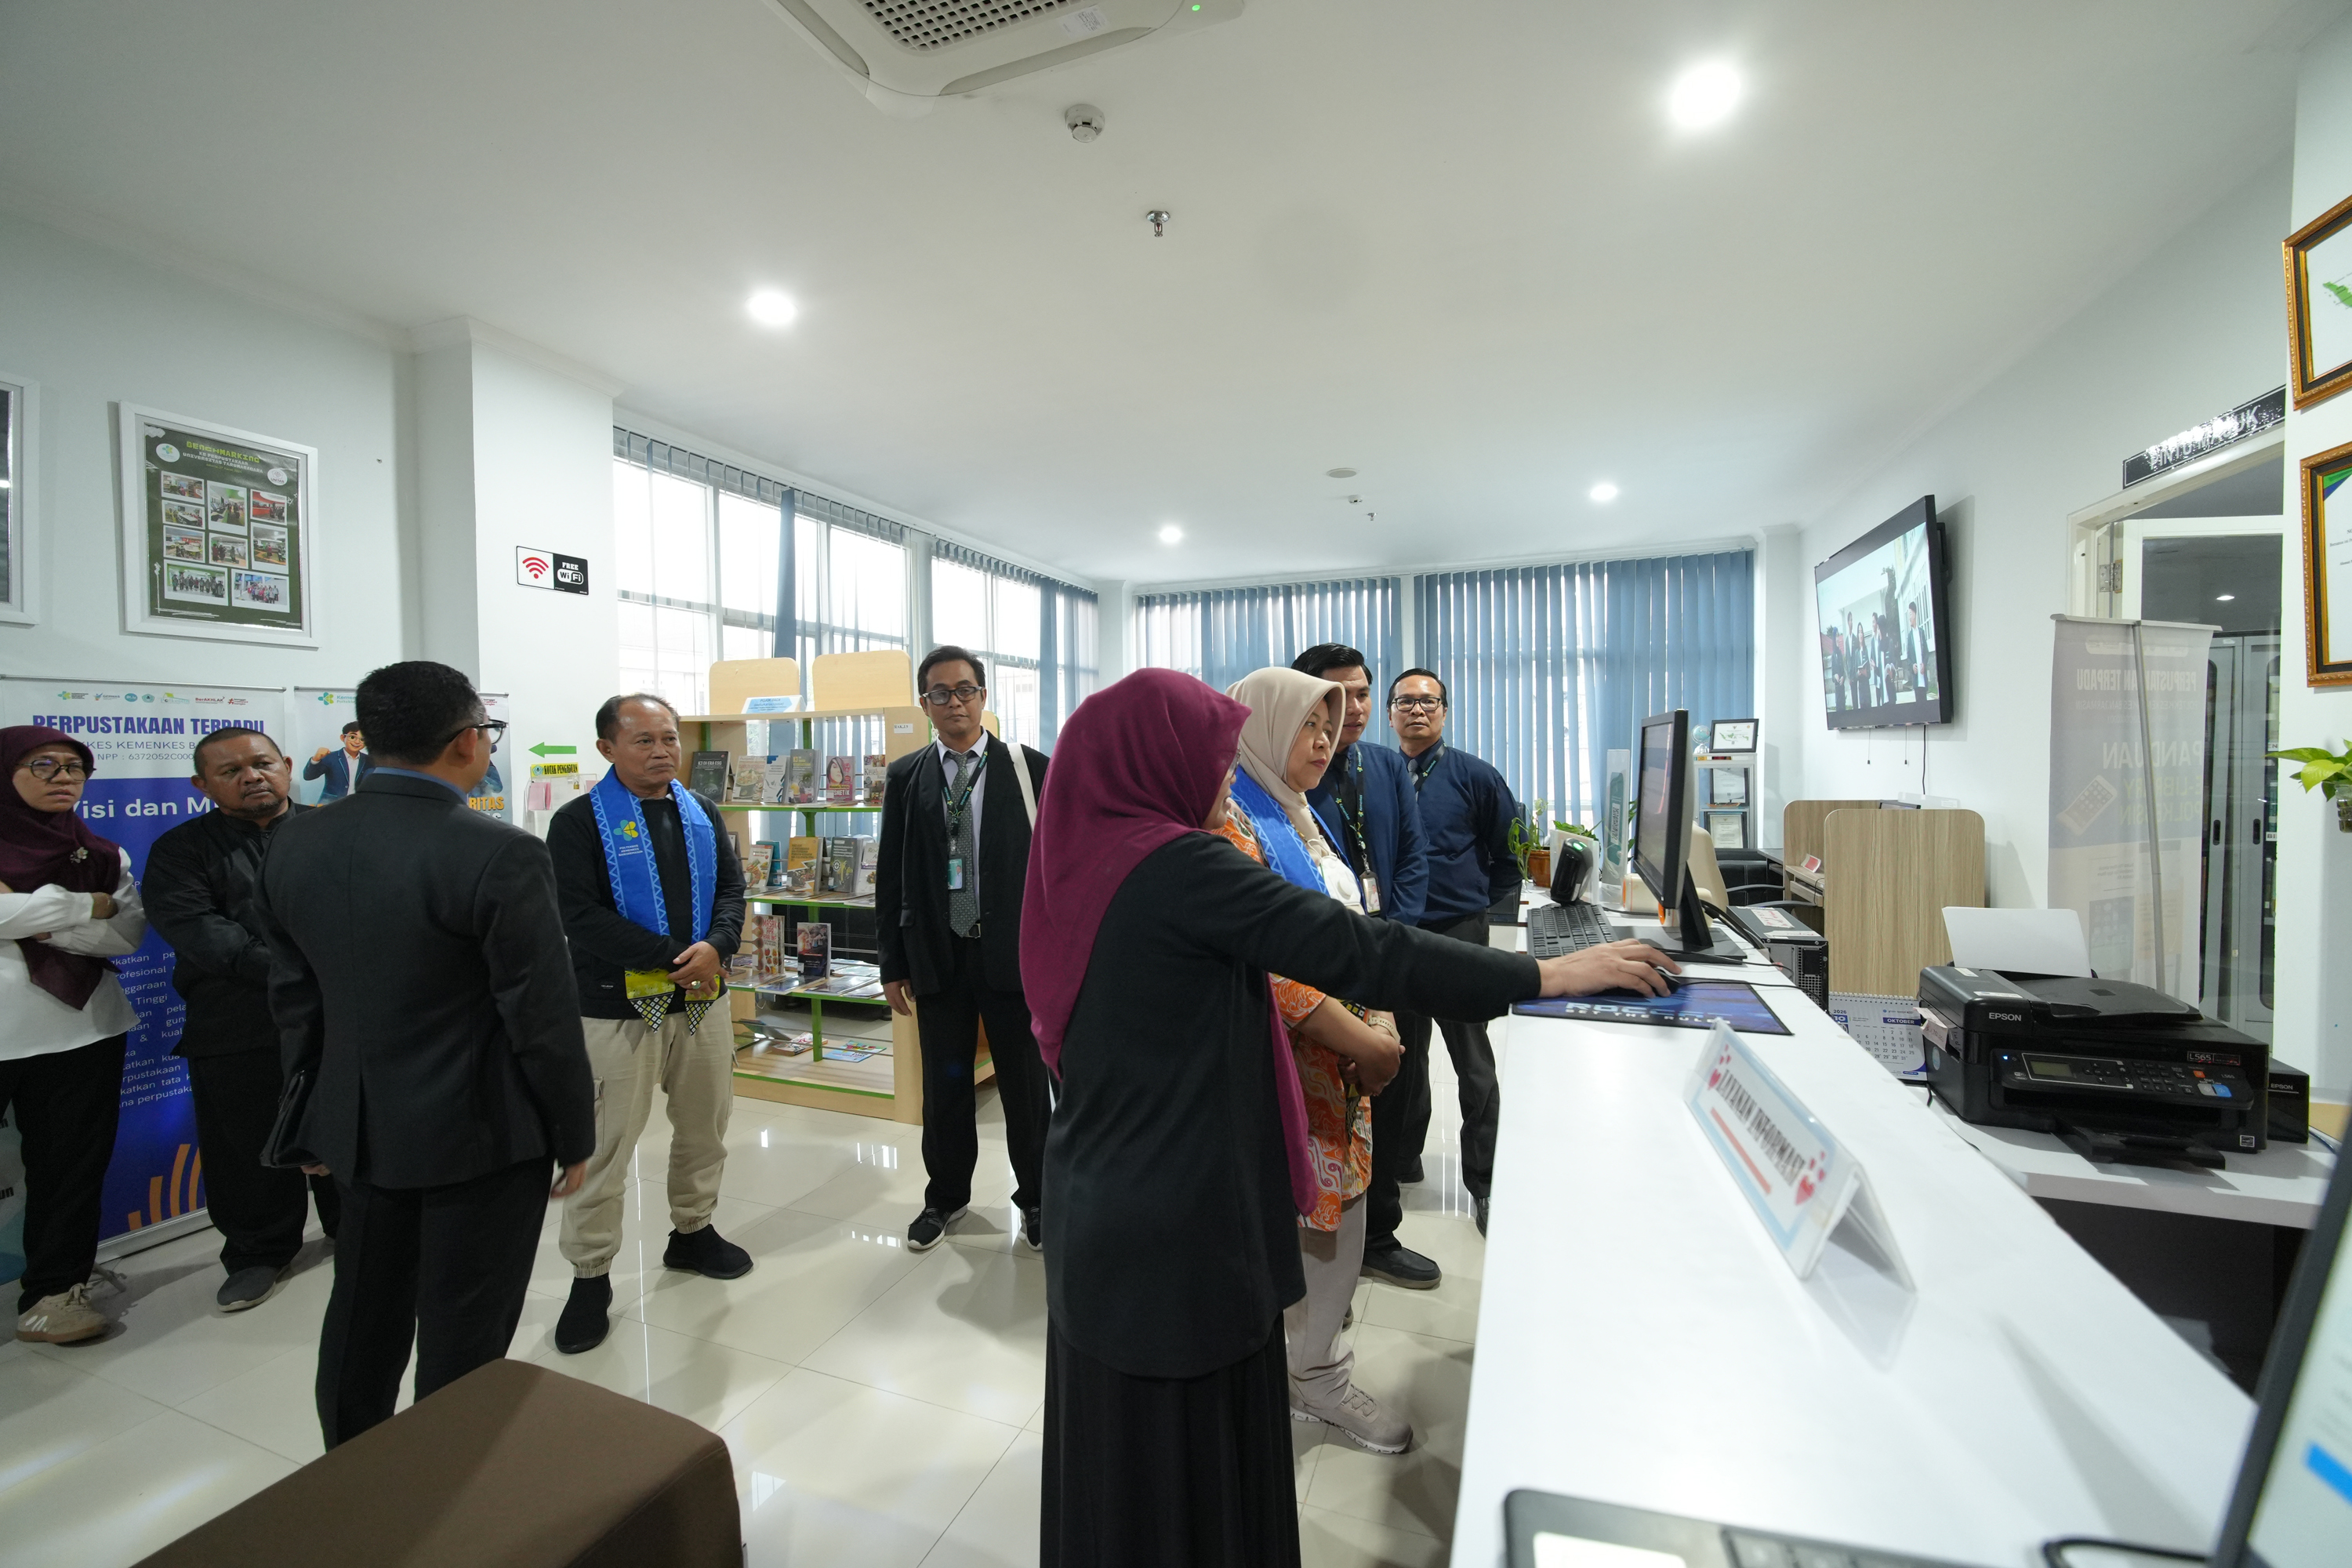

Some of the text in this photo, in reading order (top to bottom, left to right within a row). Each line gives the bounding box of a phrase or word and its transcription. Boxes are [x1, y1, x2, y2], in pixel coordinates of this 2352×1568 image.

[562, 561, 579, 571] FREE
[560, 572, 581, 582] WiFi
[543, 764, 557, 775] KOTAK
[125, 799, 177, 816] dan
[1339, 804, 1350, 820] Kemenkes
[123, 981, 166, 995] ggaraan
[136, 993, 168, 1004] Tinggi
[1566, 1002, 1733, 1018] ROCCAT
[1989, 1012, 2021, 1022] EPSON
[162, 1028, 183, 1038] kual
[122, 1065, 181, 1083] rpustakaan
[120, 1076, 181, 1095] katkan tata
[137, 1086, 192, 1105] perpustaka
[1715, 1069, 1758, 1126] LAYANAN
